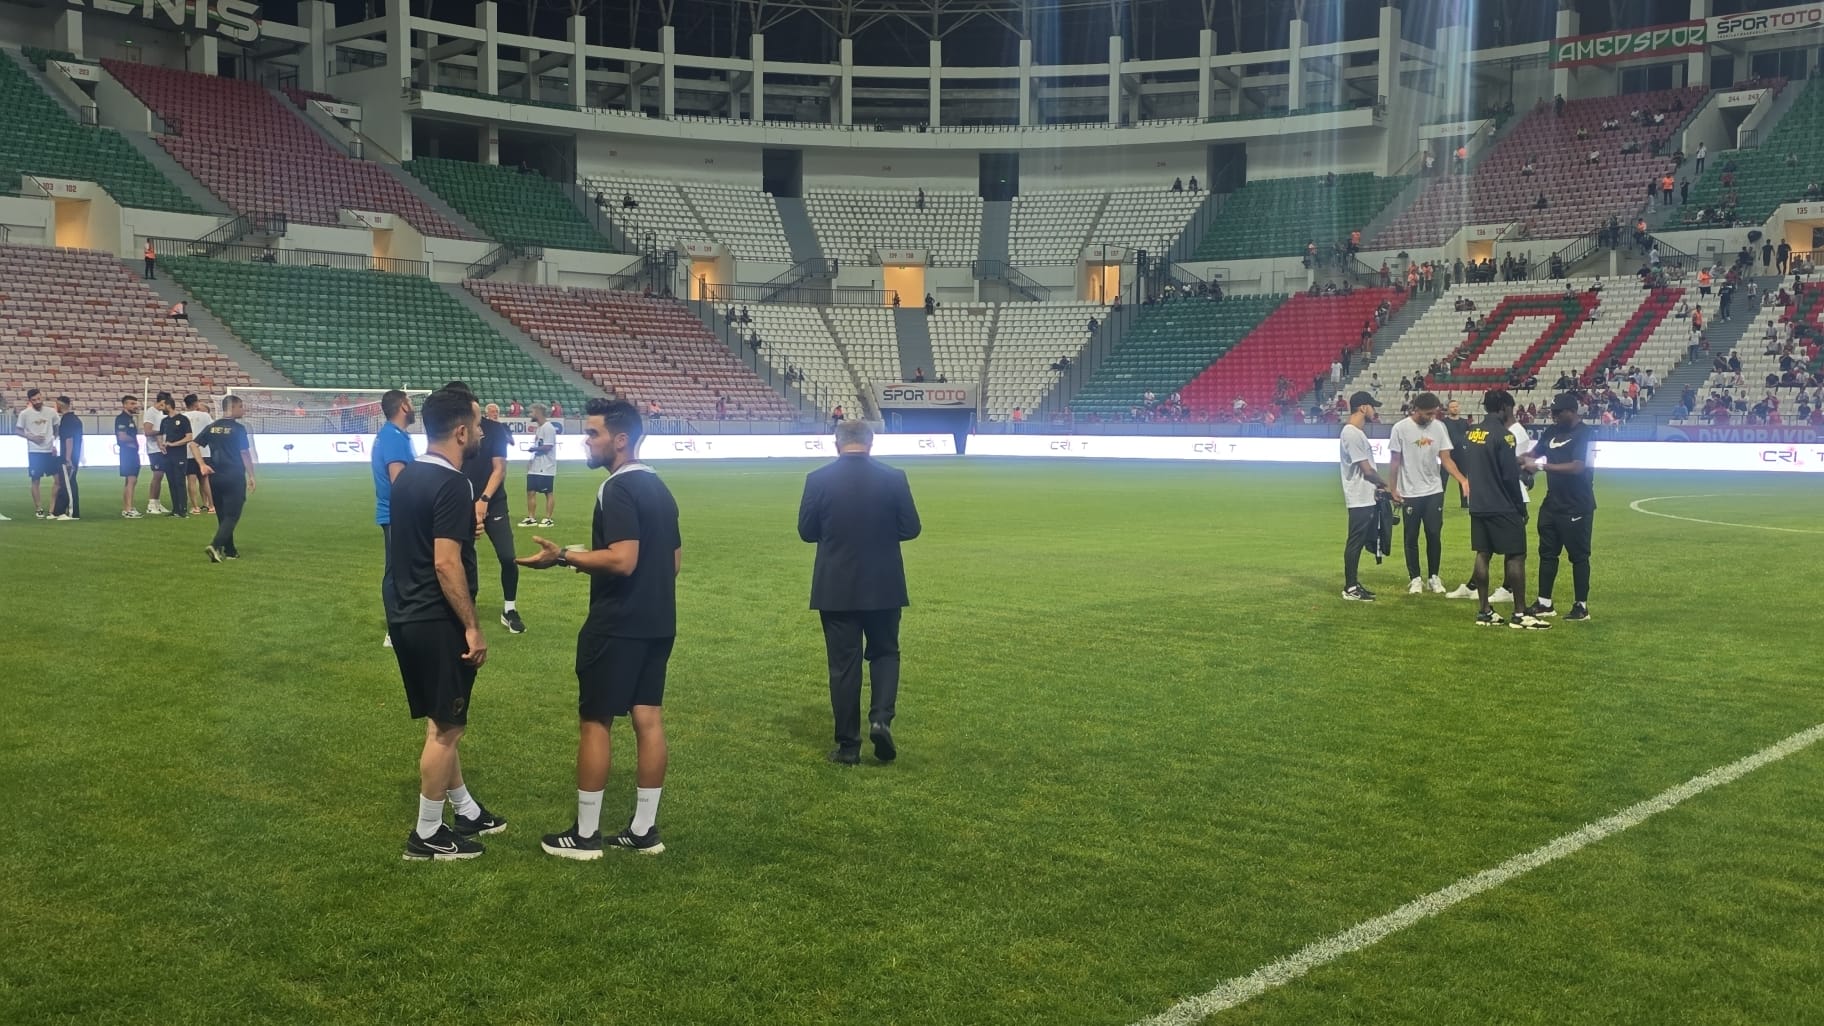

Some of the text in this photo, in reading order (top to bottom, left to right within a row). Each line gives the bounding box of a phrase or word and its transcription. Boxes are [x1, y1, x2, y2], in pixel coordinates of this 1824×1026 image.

[1558, 26, 1705, 62] AMEDSPOR
[66, 184, 77, 193] 102
[1796, 206, 1808, 215] 135
